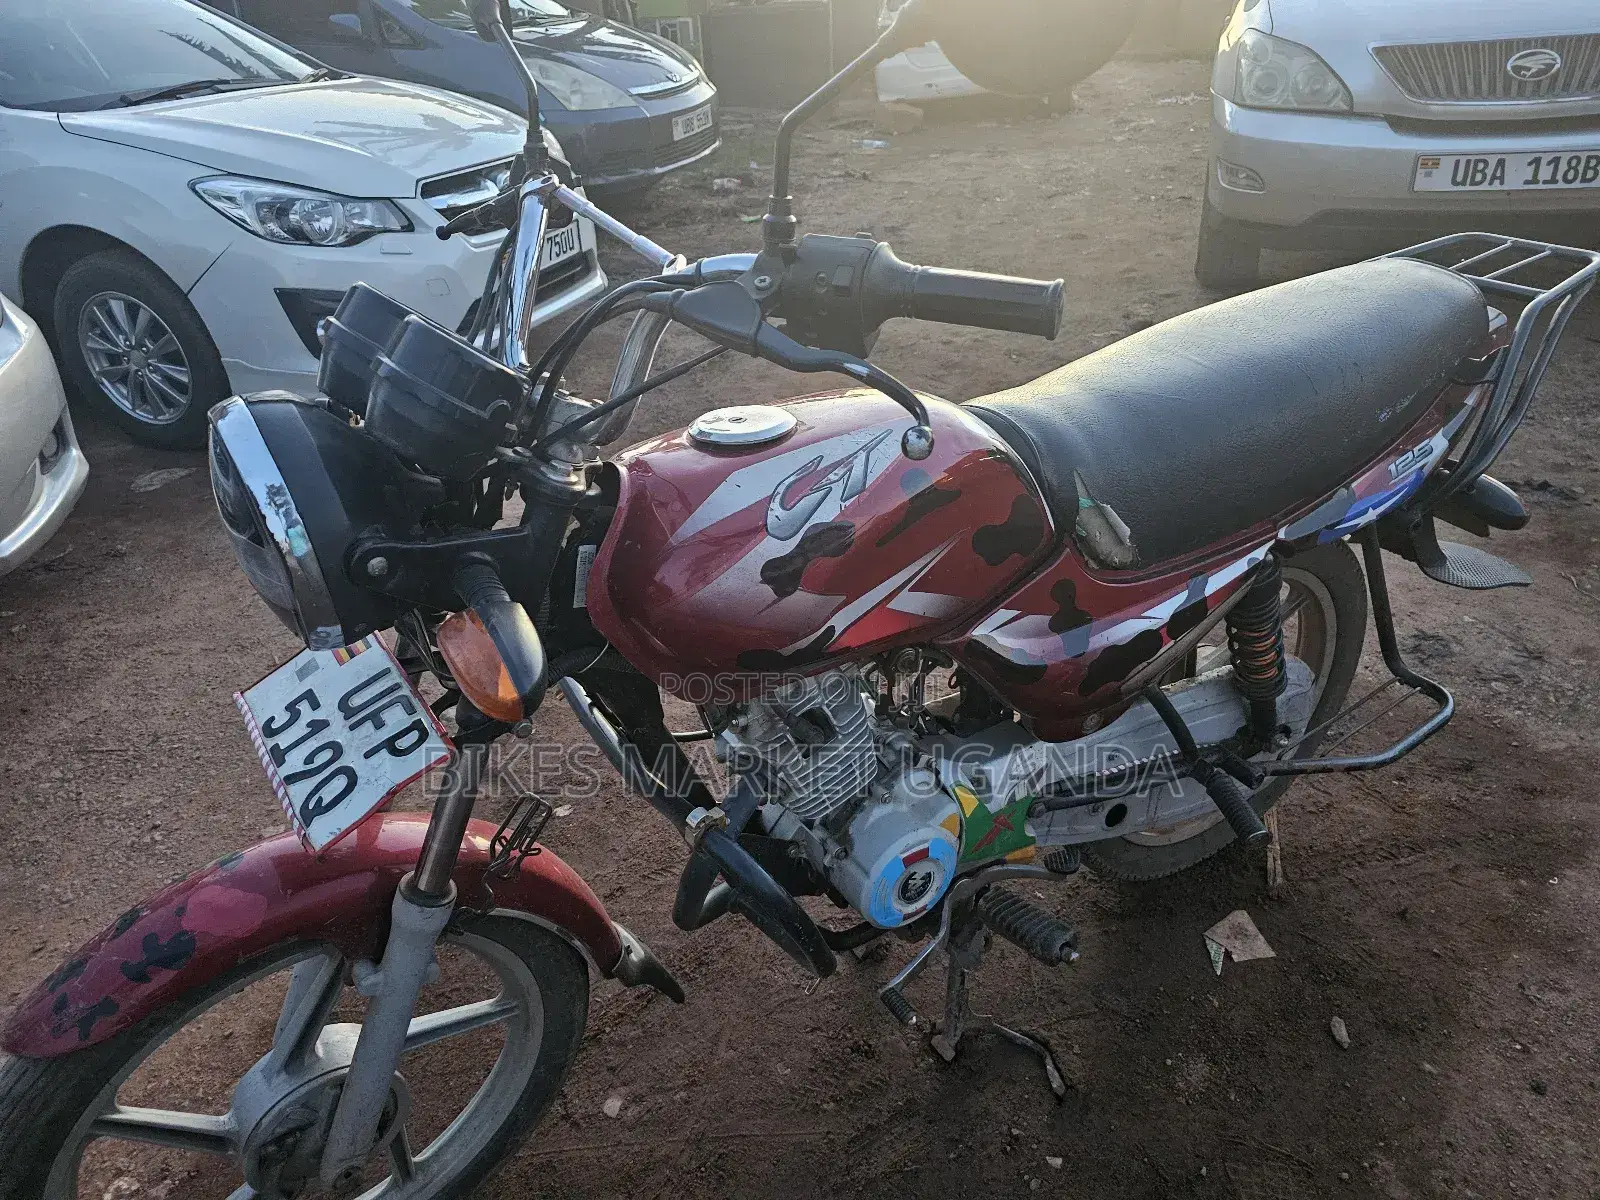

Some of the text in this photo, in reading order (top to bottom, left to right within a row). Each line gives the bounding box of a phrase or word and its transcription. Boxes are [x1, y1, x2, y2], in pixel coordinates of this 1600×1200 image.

[1450, 154, 1600, 187] UBA 118B
[1387, 438, 1434, 480] 125
[337, 666, 430, 760] UFP
[261, 687, 359, 829] 519Q
